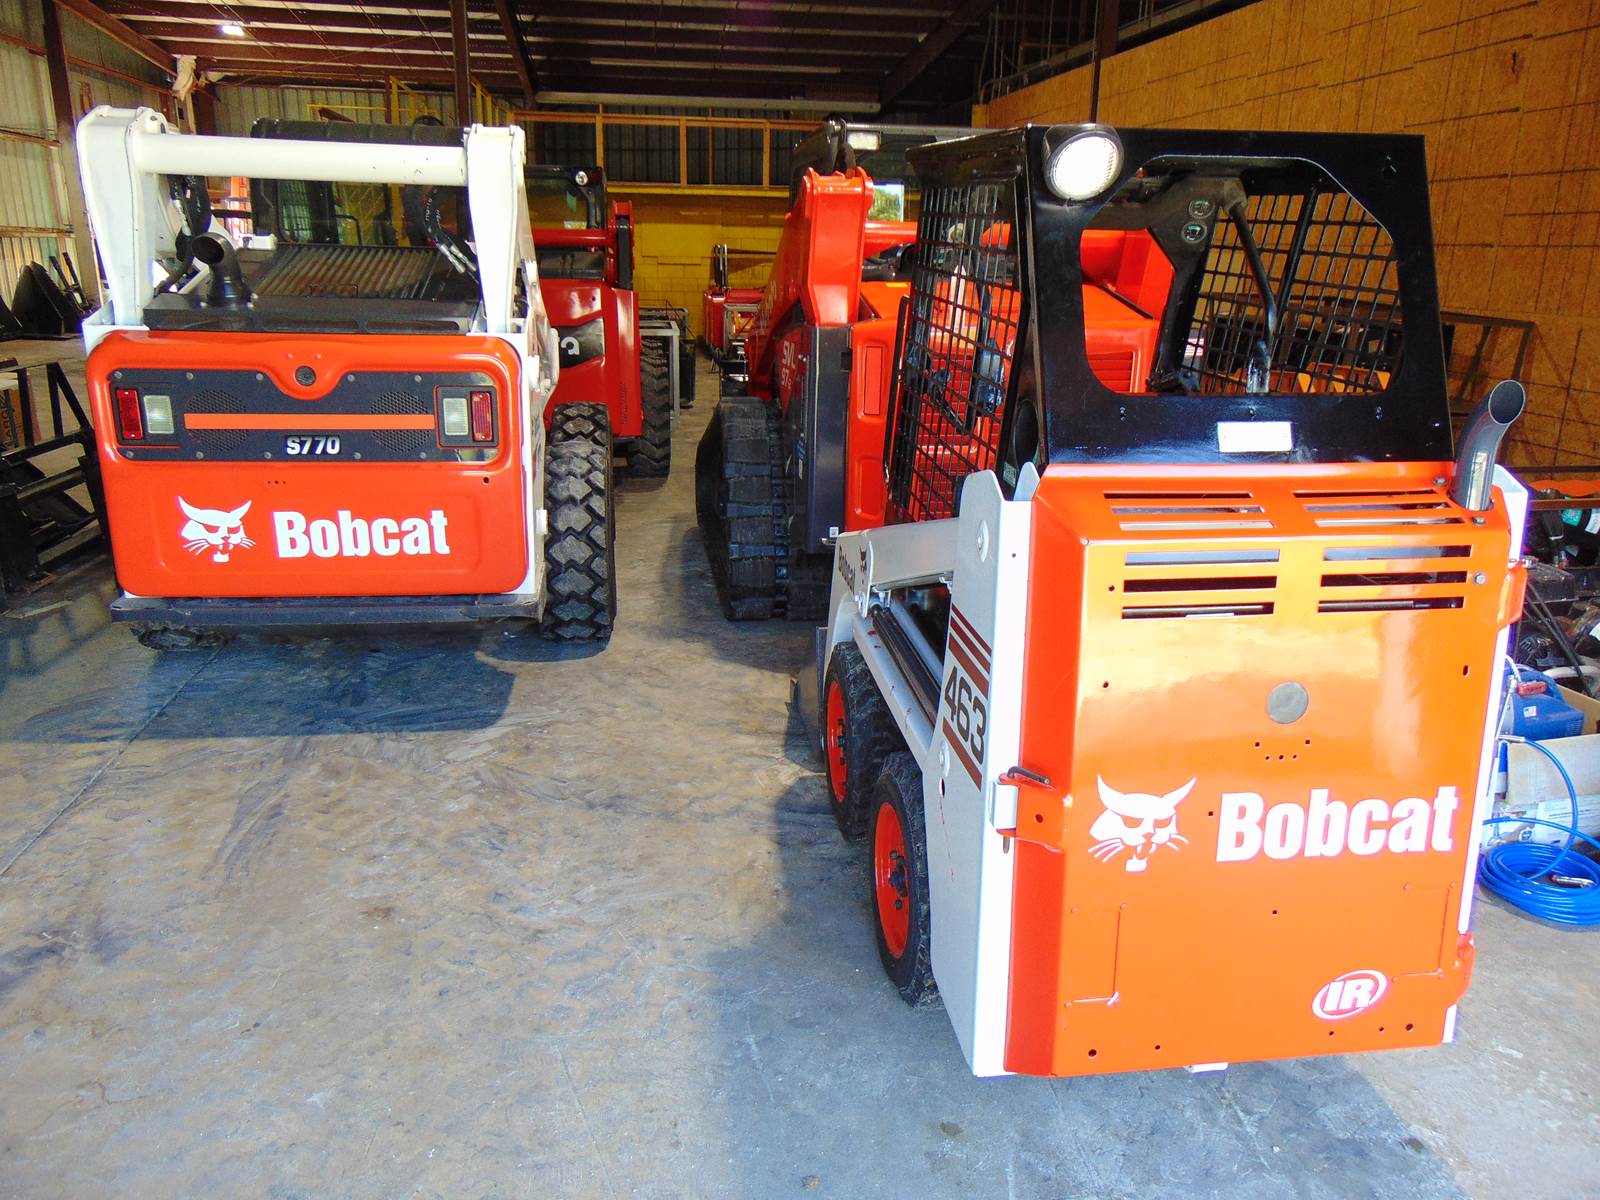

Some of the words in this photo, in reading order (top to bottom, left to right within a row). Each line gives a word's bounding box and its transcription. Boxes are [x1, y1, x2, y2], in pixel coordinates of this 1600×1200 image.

[286, 436, 340, 455] S770
[273, 510, 450, 558] Bobcat
[944, 665, 987, 765] 463
[1216, 785, 1459, 862] Bobcat
[1323, 978, 1375, 1012] IR
